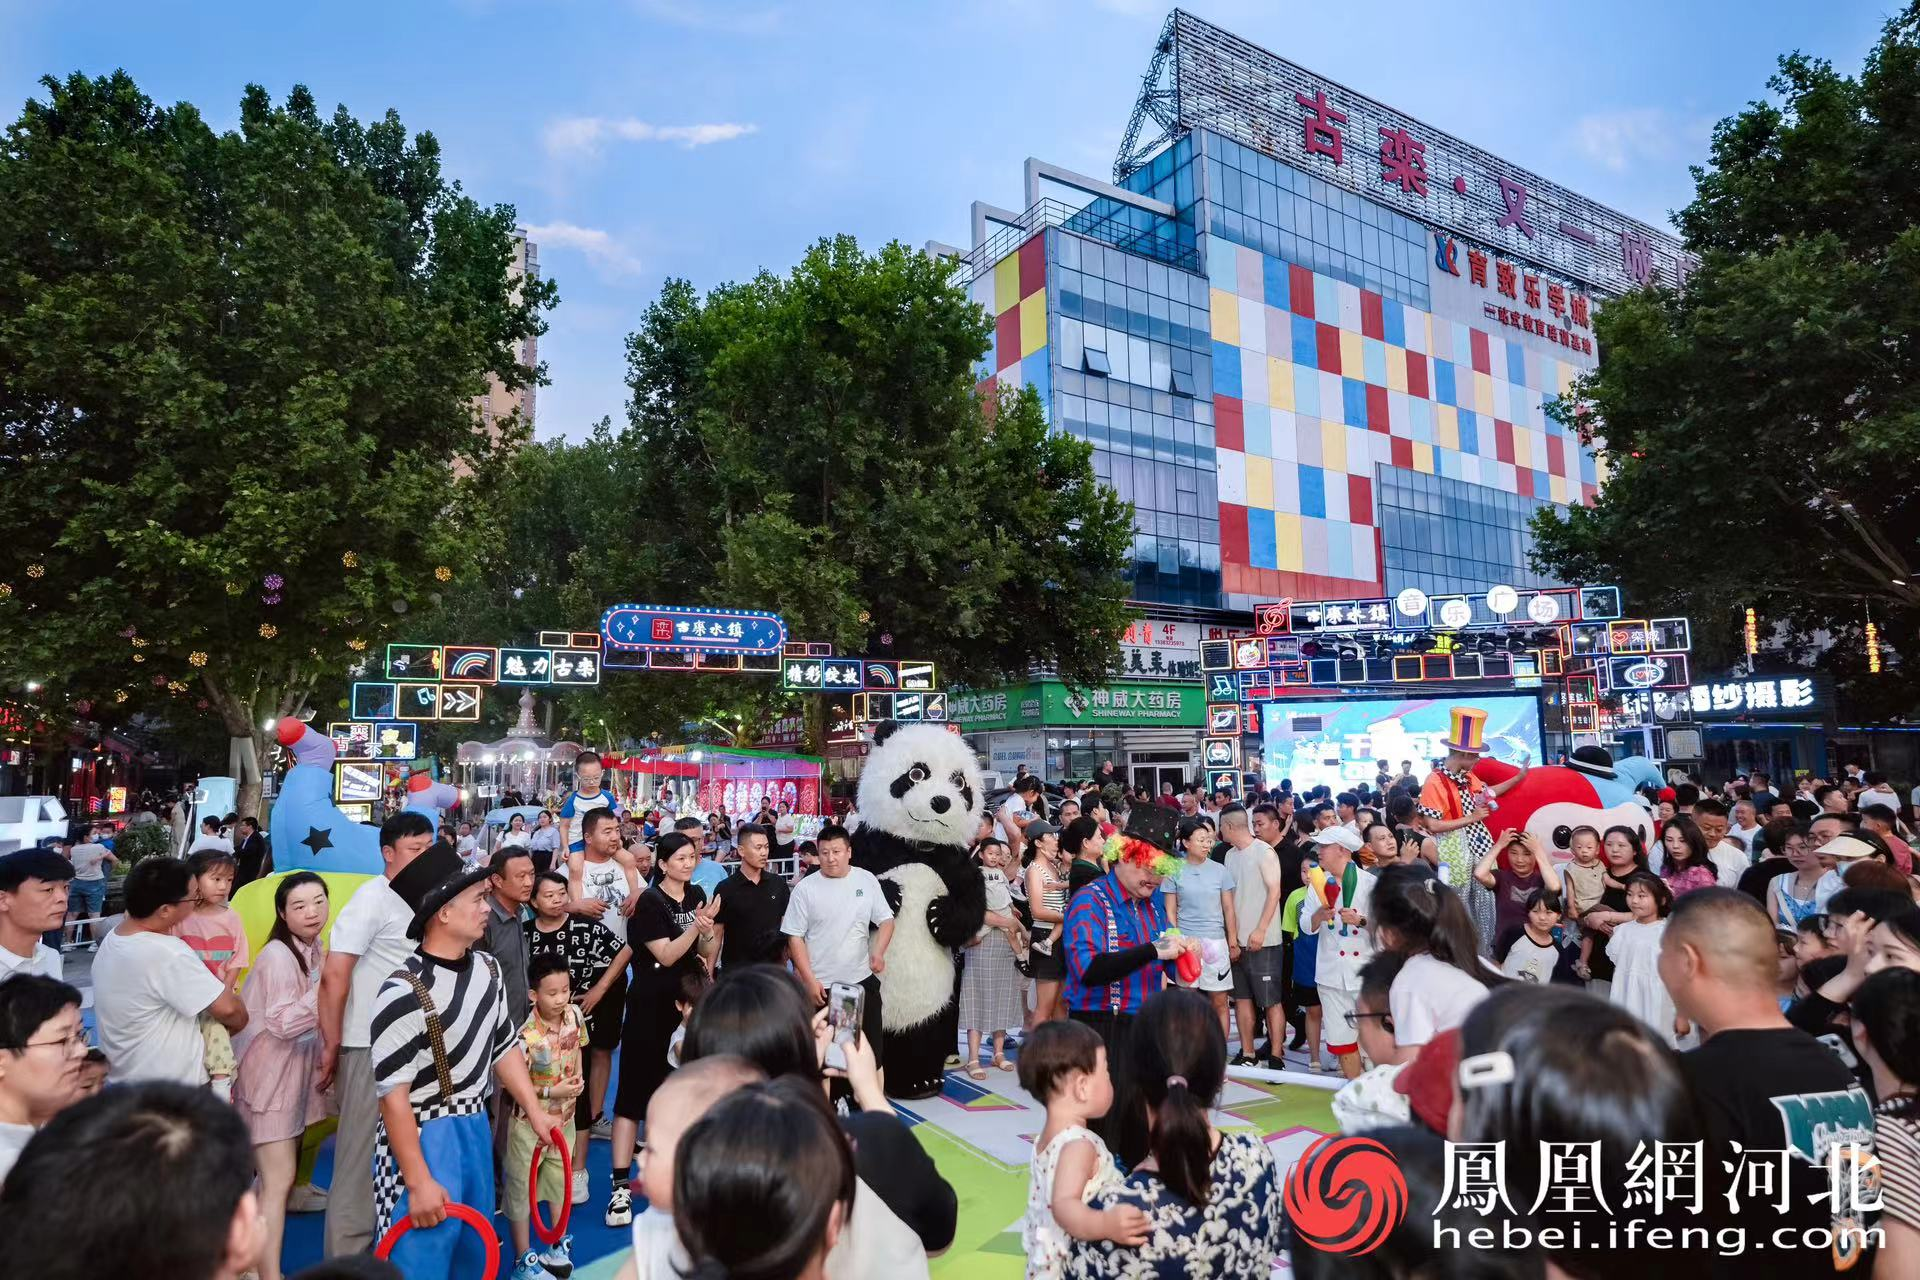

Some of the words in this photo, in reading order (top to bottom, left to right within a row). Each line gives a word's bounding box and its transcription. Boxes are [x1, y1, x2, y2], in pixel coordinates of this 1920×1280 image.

[1484, 304, 1592, 355] 一站式教育培训基地
[1162, 624, 1176, 635] 4F
[1091, 689, 1182, 709] 神威大药房
[1092, 709, 1136, 718] SHINEWAY
[1138, 710, 1181, 718] PHARMACY
